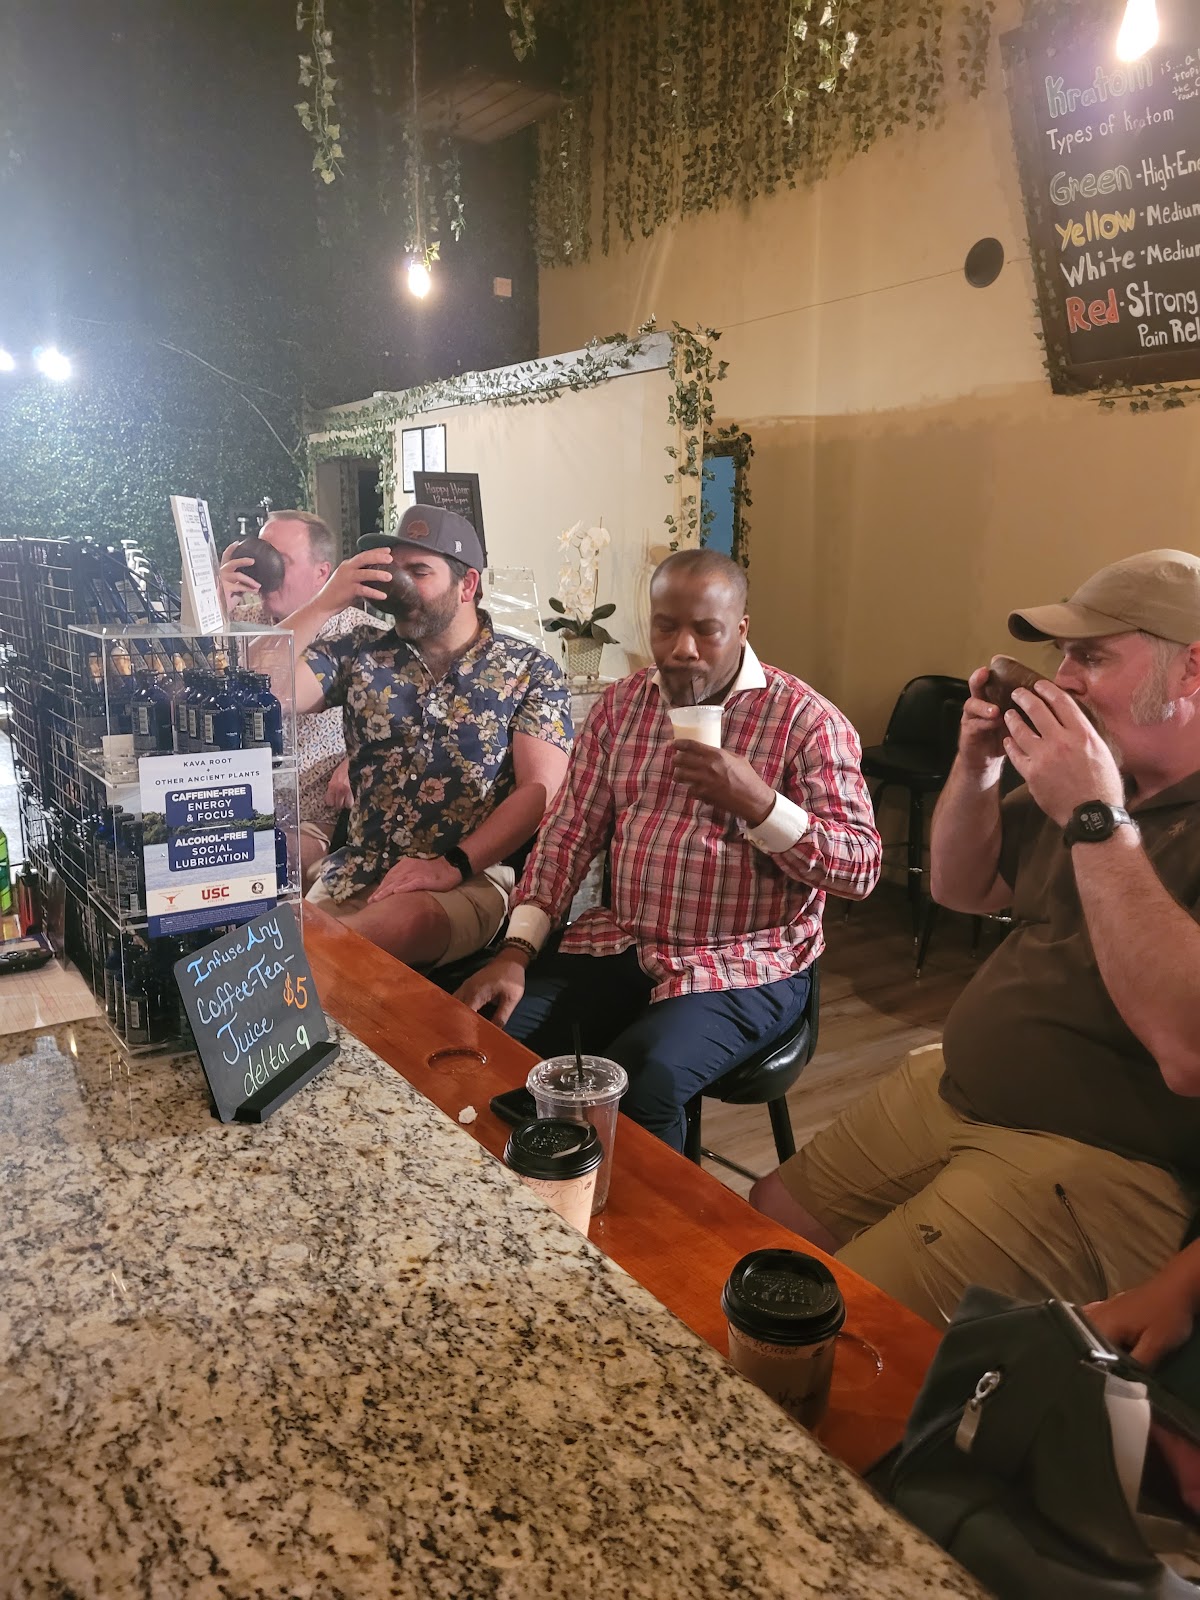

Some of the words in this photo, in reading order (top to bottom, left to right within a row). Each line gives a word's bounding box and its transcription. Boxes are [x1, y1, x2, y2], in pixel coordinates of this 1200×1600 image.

[1045, 57, 1153, 118] Kratom
[1171, 84, 1191, 96] the
[1046, 126, 1092, 155] Types
[1100, 114, 1115, 136] of
[1050, 165, 1133, 206] Green
[1060, 246, 1136, 288] White
[1066, 288, 1120, 334] Red
[1126, 280, 1198, 318] Strong
[1137, 324, 1168, 348] Pain
[424, 482, 449, 496] Happy
[184, 760, 206, 768] KAVA
[155, 778, 184, 786] OTHER
[188, 774, 225, 783] ANCIENT
[228, 770, 260, 779] PLANTS
[172, 787, 246, 802] CAFFEINE-FREE
[188, 799, 232, 812] ENERGY
[186, 814, 194, 822] &
[198, 810, 234, 821] FOCUS
[175, 831, 248, 848] ALCOHOL-FREE
[192, 844, 232, 856] SOCIAL
[176, 852, 249, 869] LUBRICATION
[202, 886, 230, 900] USC
[187, 944, 246, 987] Infuse
[247, 918, 284, 950] Any
[283, 972, 308, 1010] $5
[216, 1012, 274, 1065] Juice
[244, 1024, 311, 1097] delta-9
